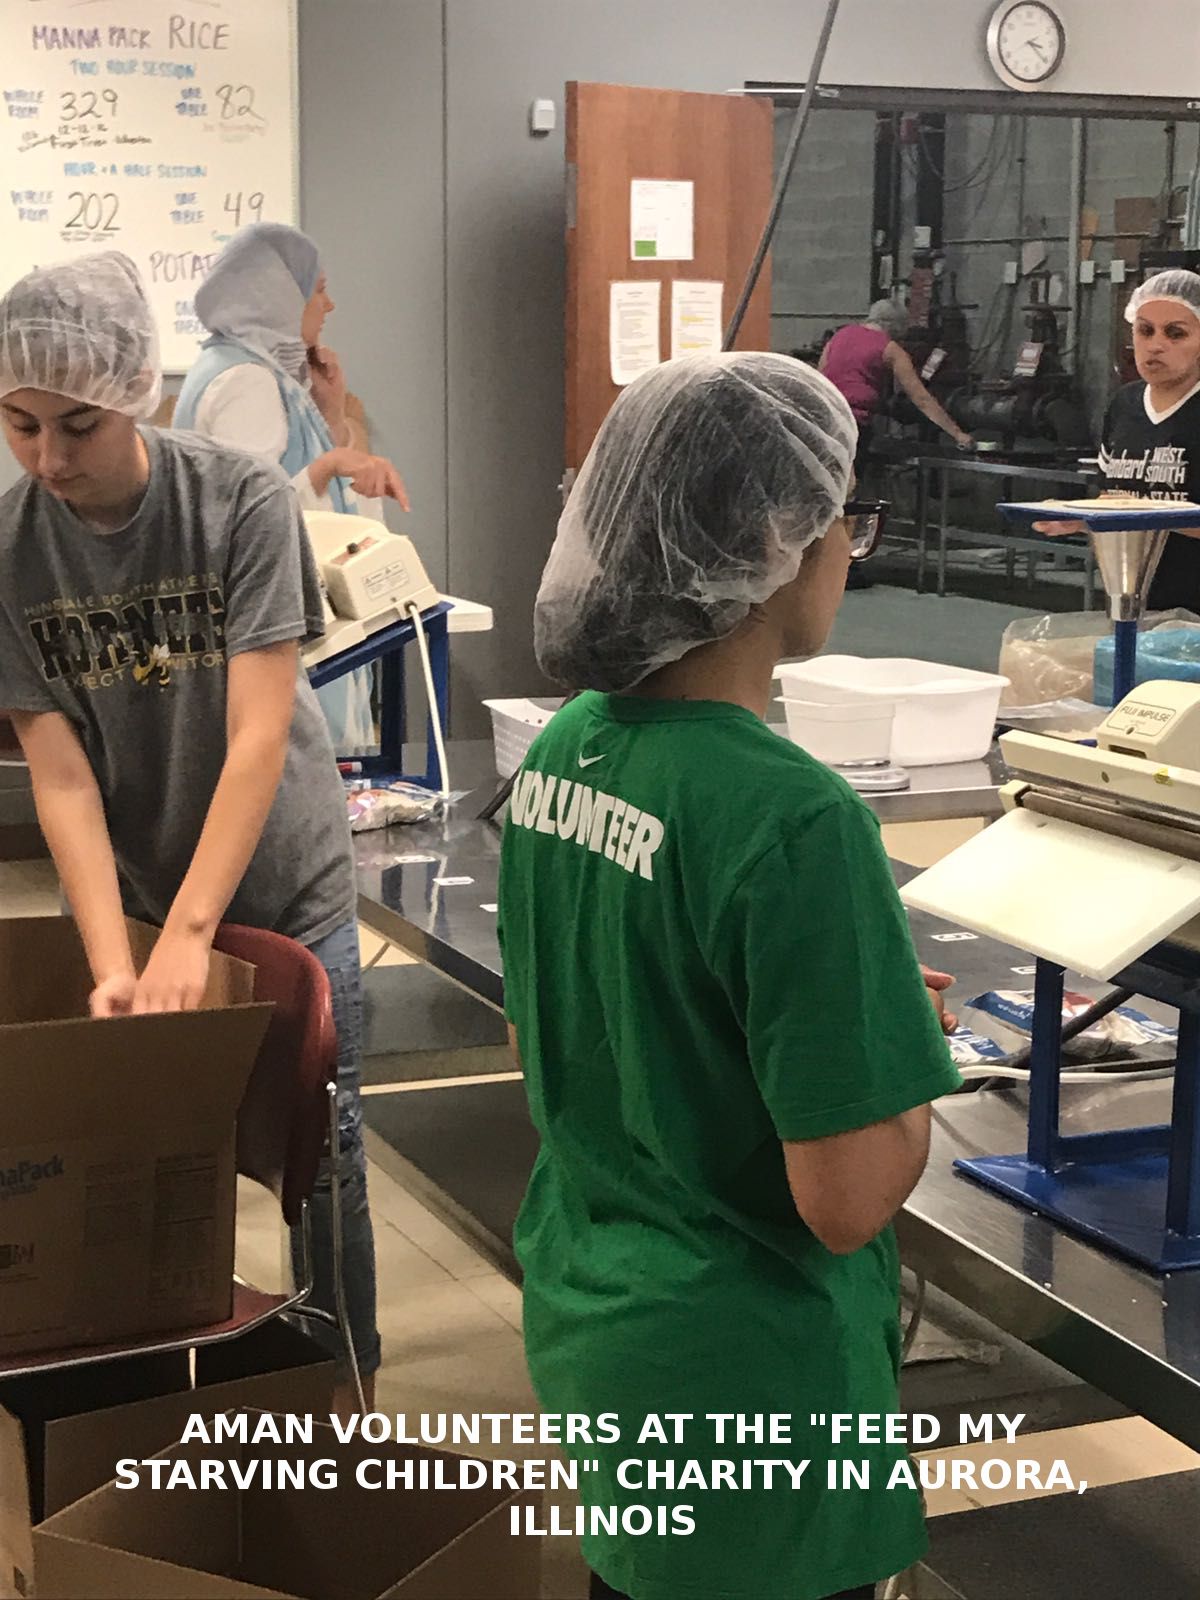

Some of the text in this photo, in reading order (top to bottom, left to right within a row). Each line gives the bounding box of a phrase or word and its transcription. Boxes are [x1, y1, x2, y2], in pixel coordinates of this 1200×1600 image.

[32, 15, 230, 50] MANNA PACK RICE
[59, 88, 118, 121] 329
[216, 84, 267, 121] 82
[65, 191, 121, 231] 202
[223, 191, 264, 227] 49
[1152, 446, 1186, 463] WEST
[1144, 465, 1186, 484] SOUTH
[511, 770, 665, 881] VOLUNTEER
